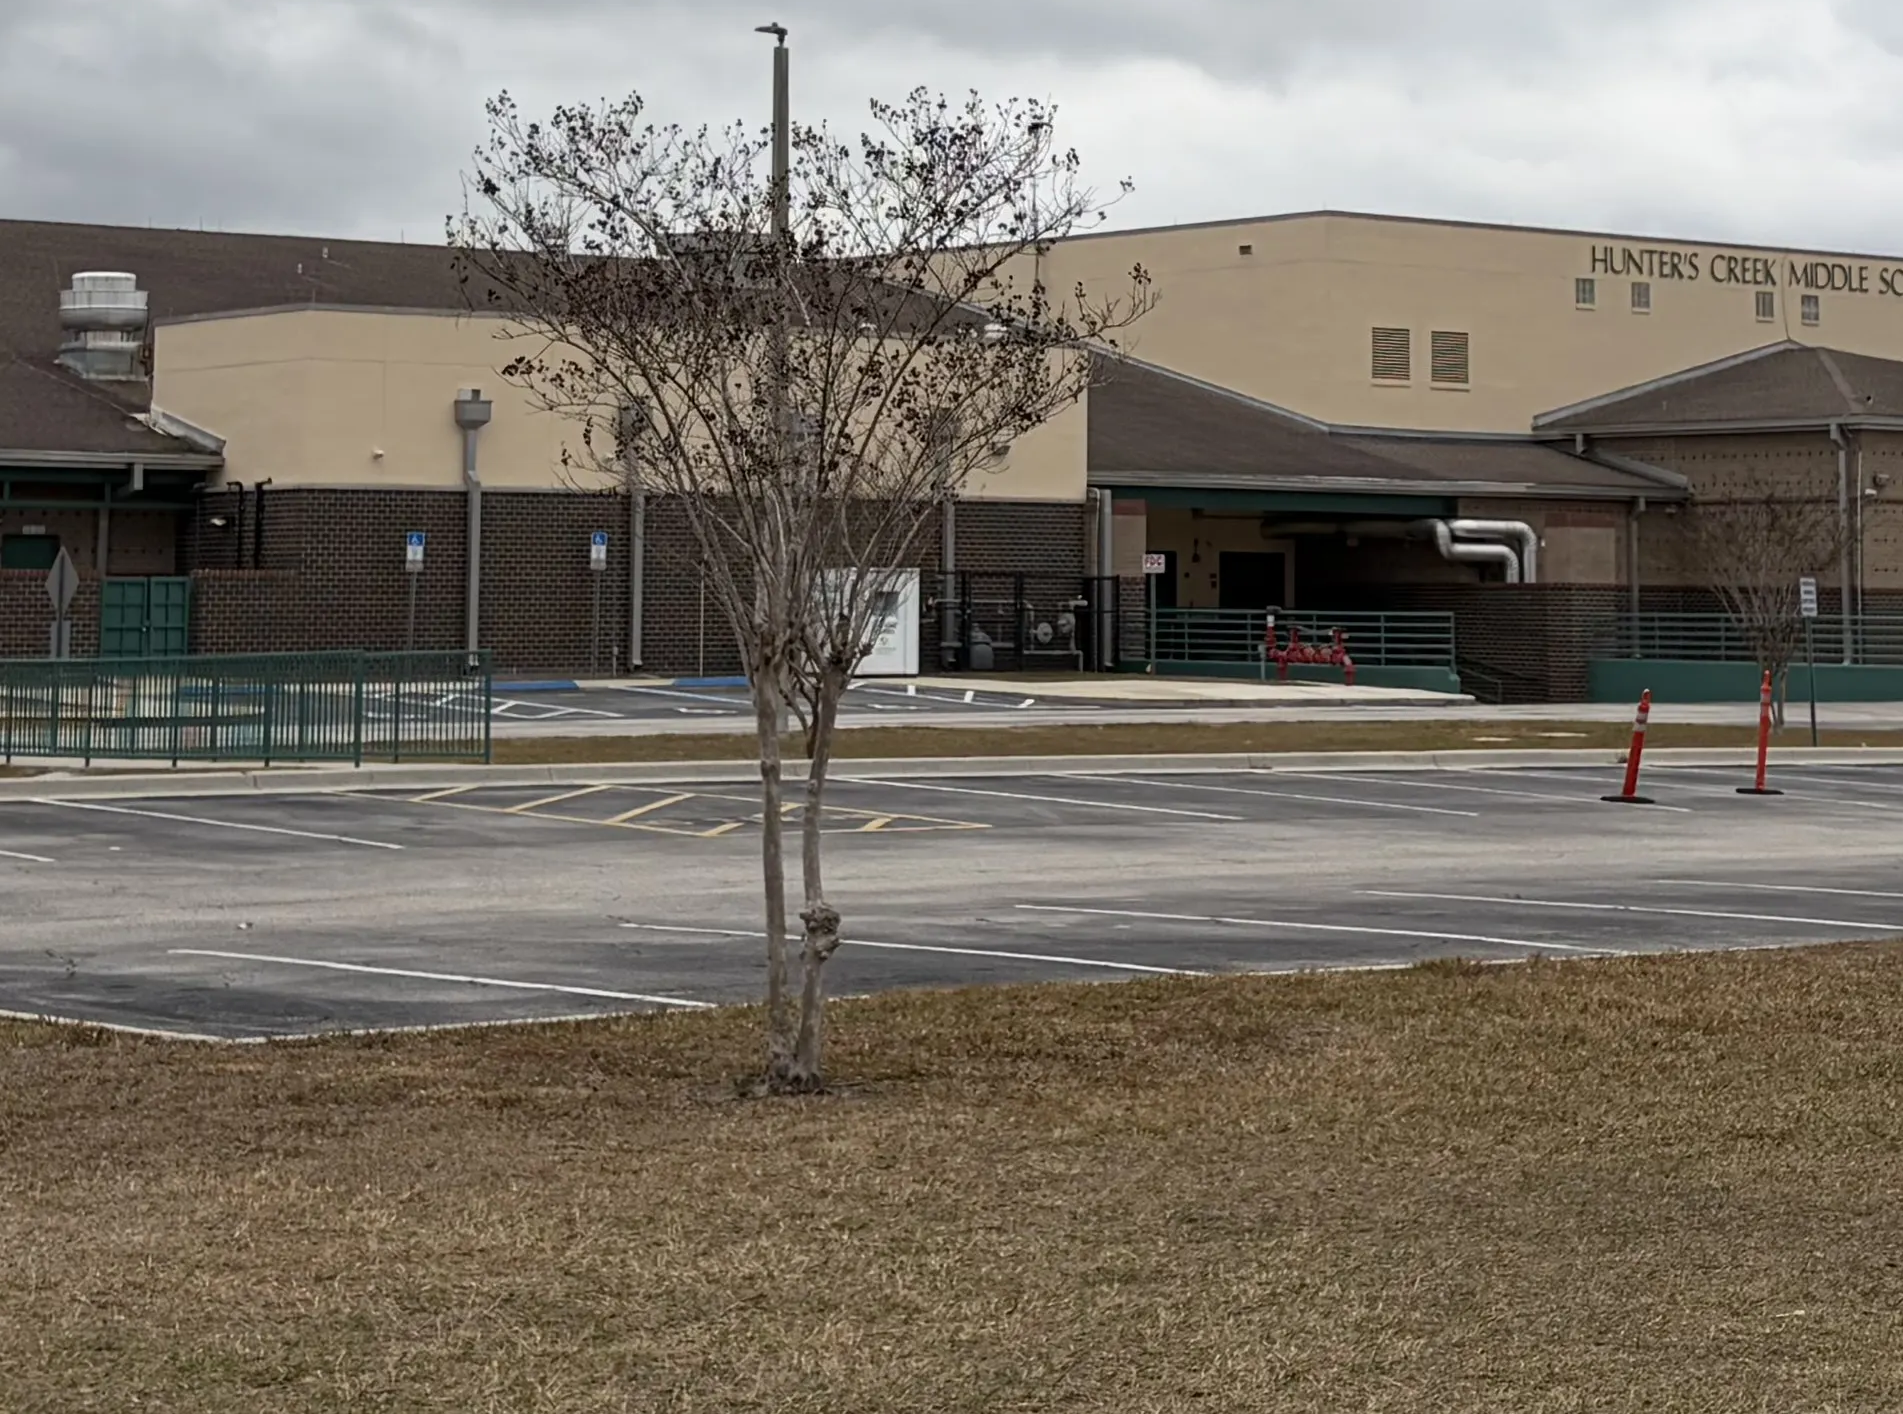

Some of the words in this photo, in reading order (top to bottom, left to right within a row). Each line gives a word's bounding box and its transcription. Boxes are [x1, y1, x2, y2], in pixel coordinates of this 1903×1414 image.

[1591, 246, 1699, 281] HUNTER'S
[1710, 254, 1777, 287] CREEK
[1788, 261, 1869, 293] MIDDLE
